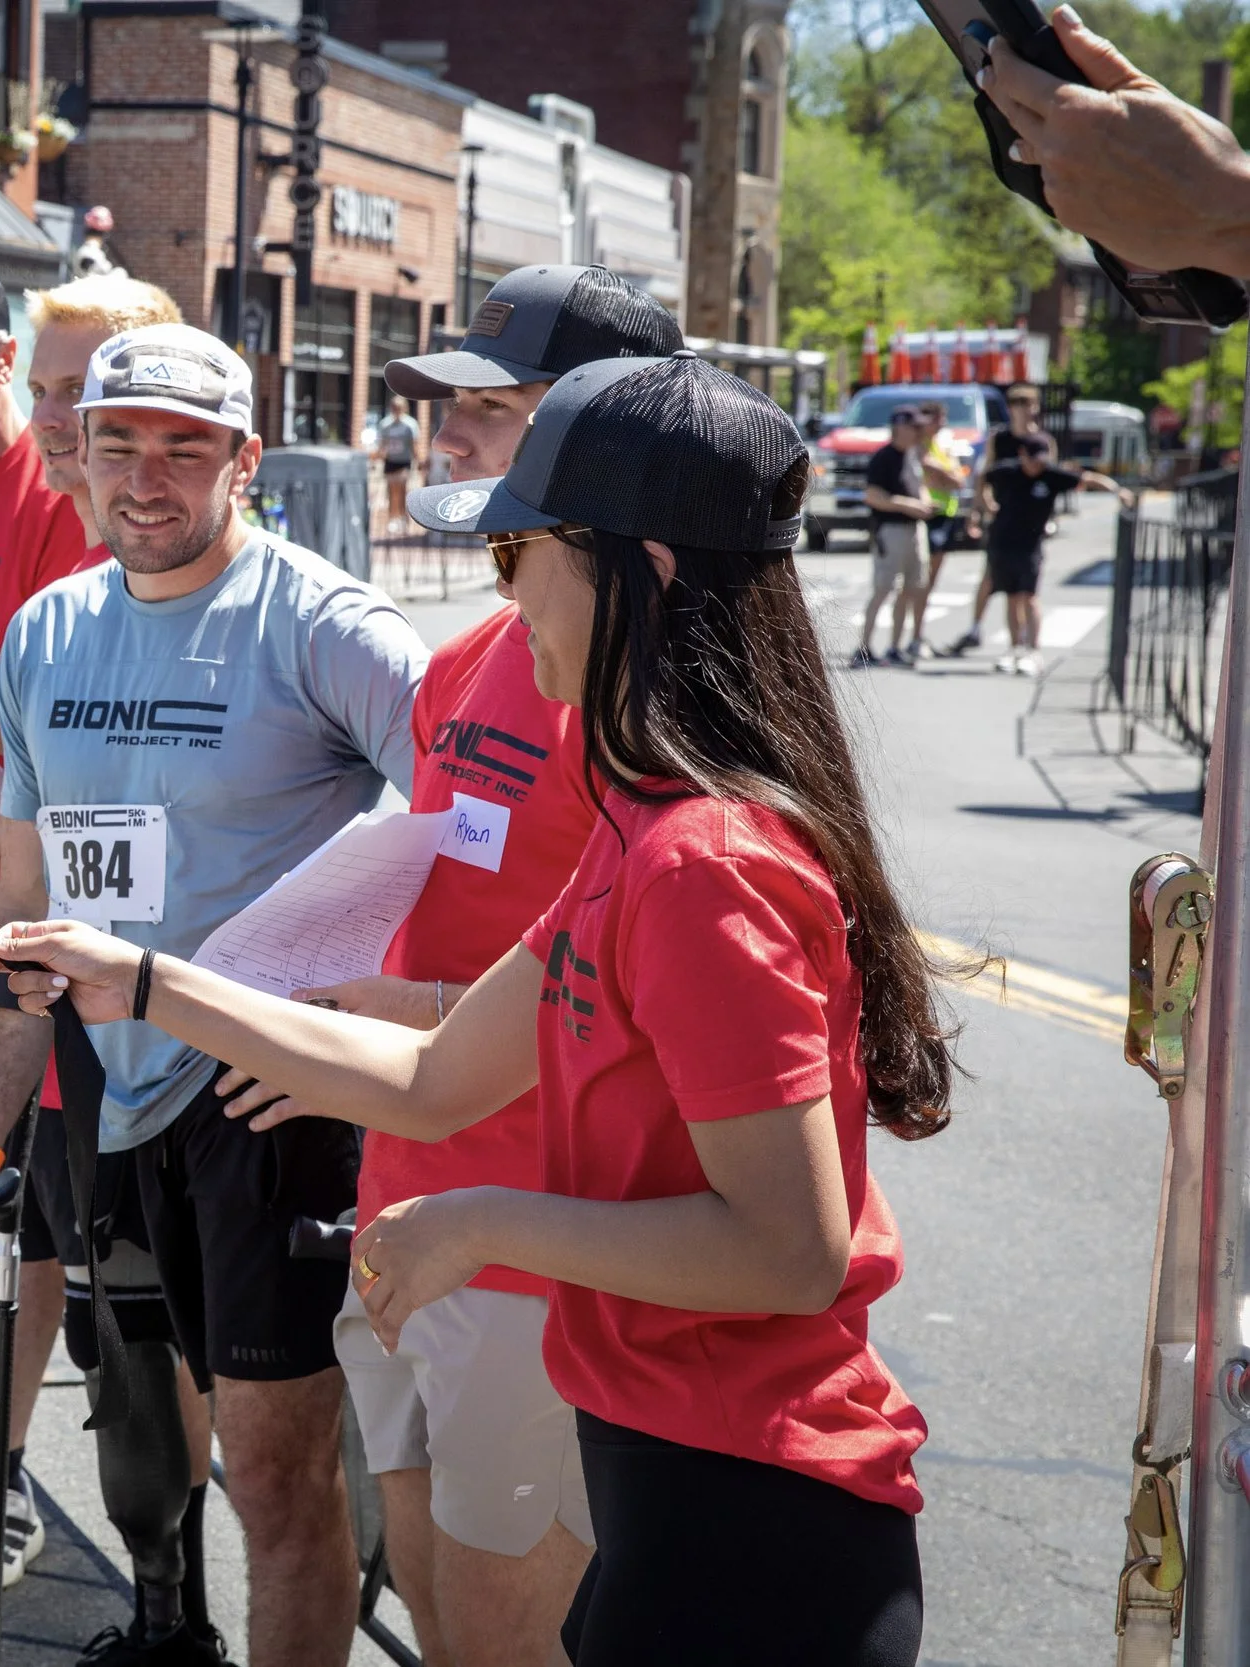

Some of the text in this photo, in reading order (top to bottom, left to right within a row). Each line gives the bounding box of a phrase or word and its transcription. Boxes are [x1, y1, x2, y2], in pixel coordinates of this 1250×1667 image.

[289, 14, 331, 250] SOURCE
[48, 700, 228, 734] BIONIC
[105, 735, 222, 749] PROJECT INC
[495, 781, 528, 803] INC
[50, 809, 127, 829] BIONIC
[455, 813, 490, 845] Ryan
[62, 840, 134, 899] 384
